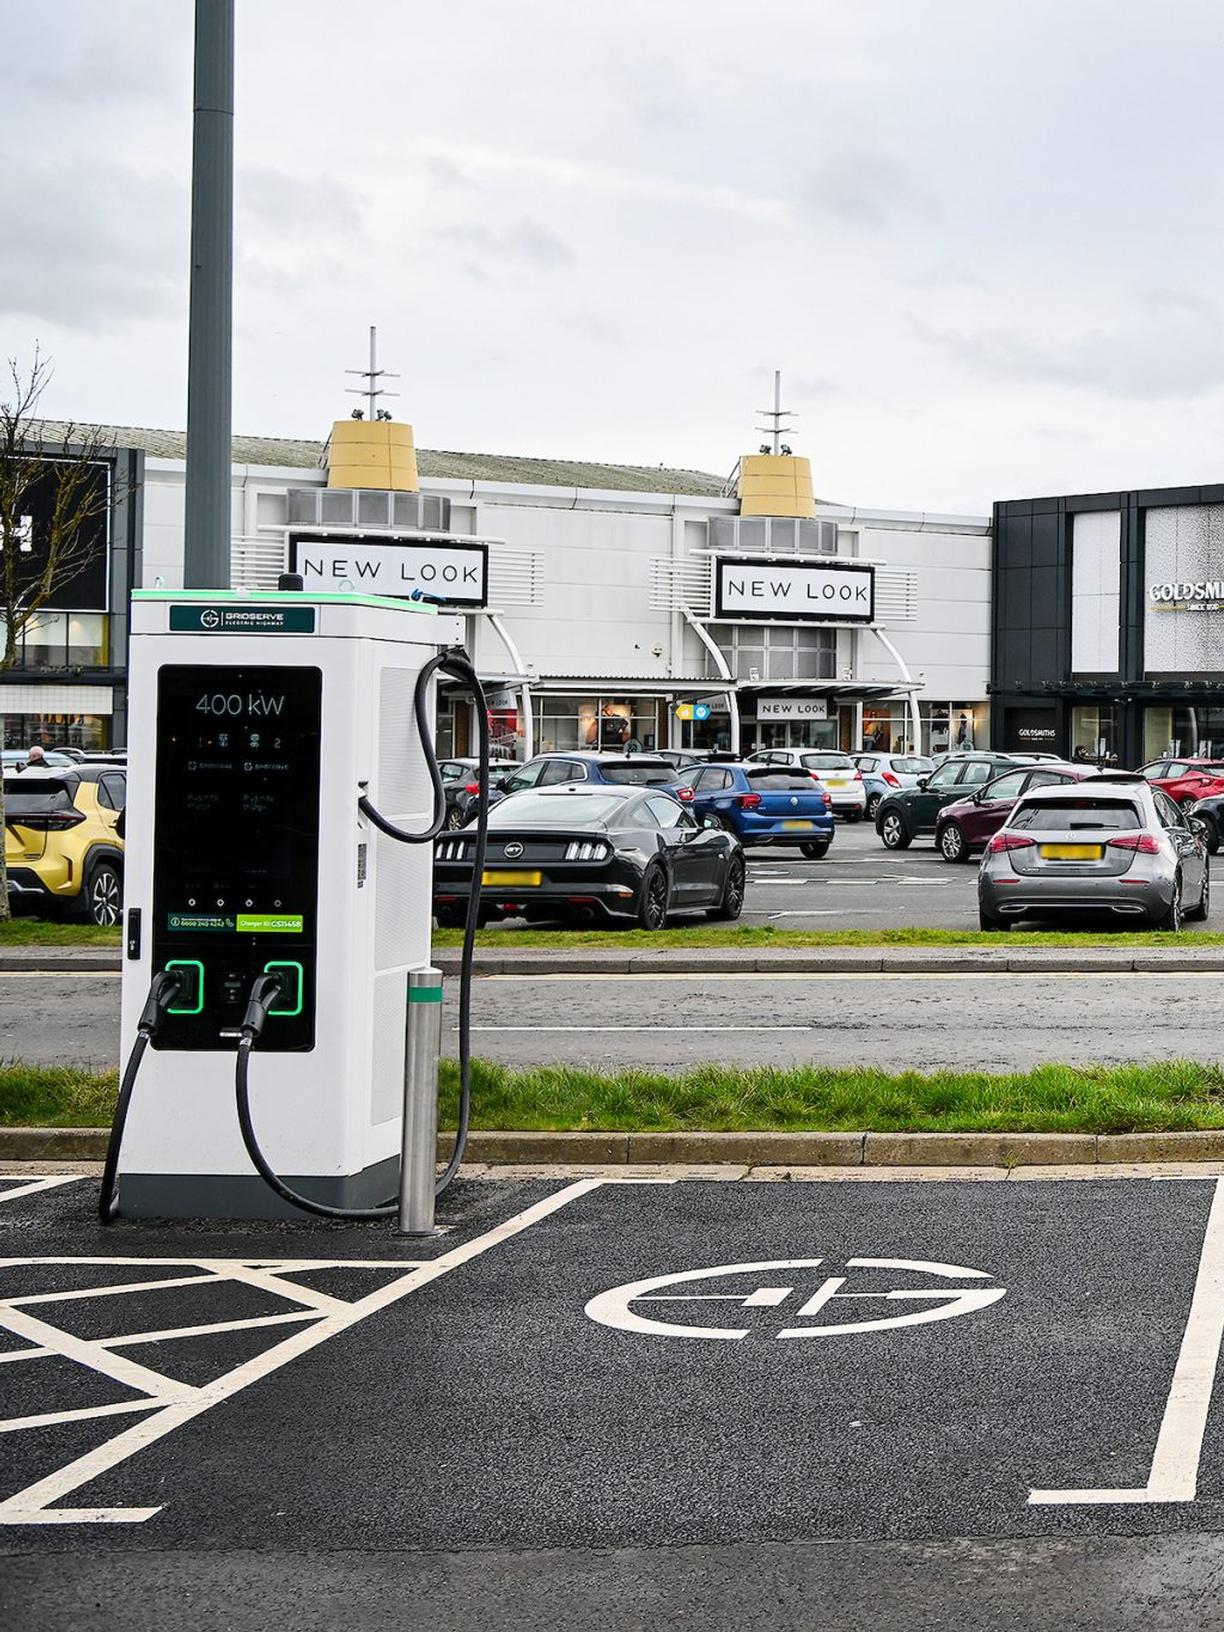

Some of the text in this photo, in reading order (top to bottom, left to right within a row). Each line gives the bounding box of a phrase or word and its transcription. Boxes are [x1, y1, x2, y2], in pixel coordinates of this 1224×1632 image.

[304, 558, 479, 584] NEW LOOK
[728, 580, 868, 602] NEW LOOK
[225, 612, 284, 621] GRIDSERVE
[195, 693, 285, 715] 400 kW
[762, 704, 826, 714] NEW LOOK
